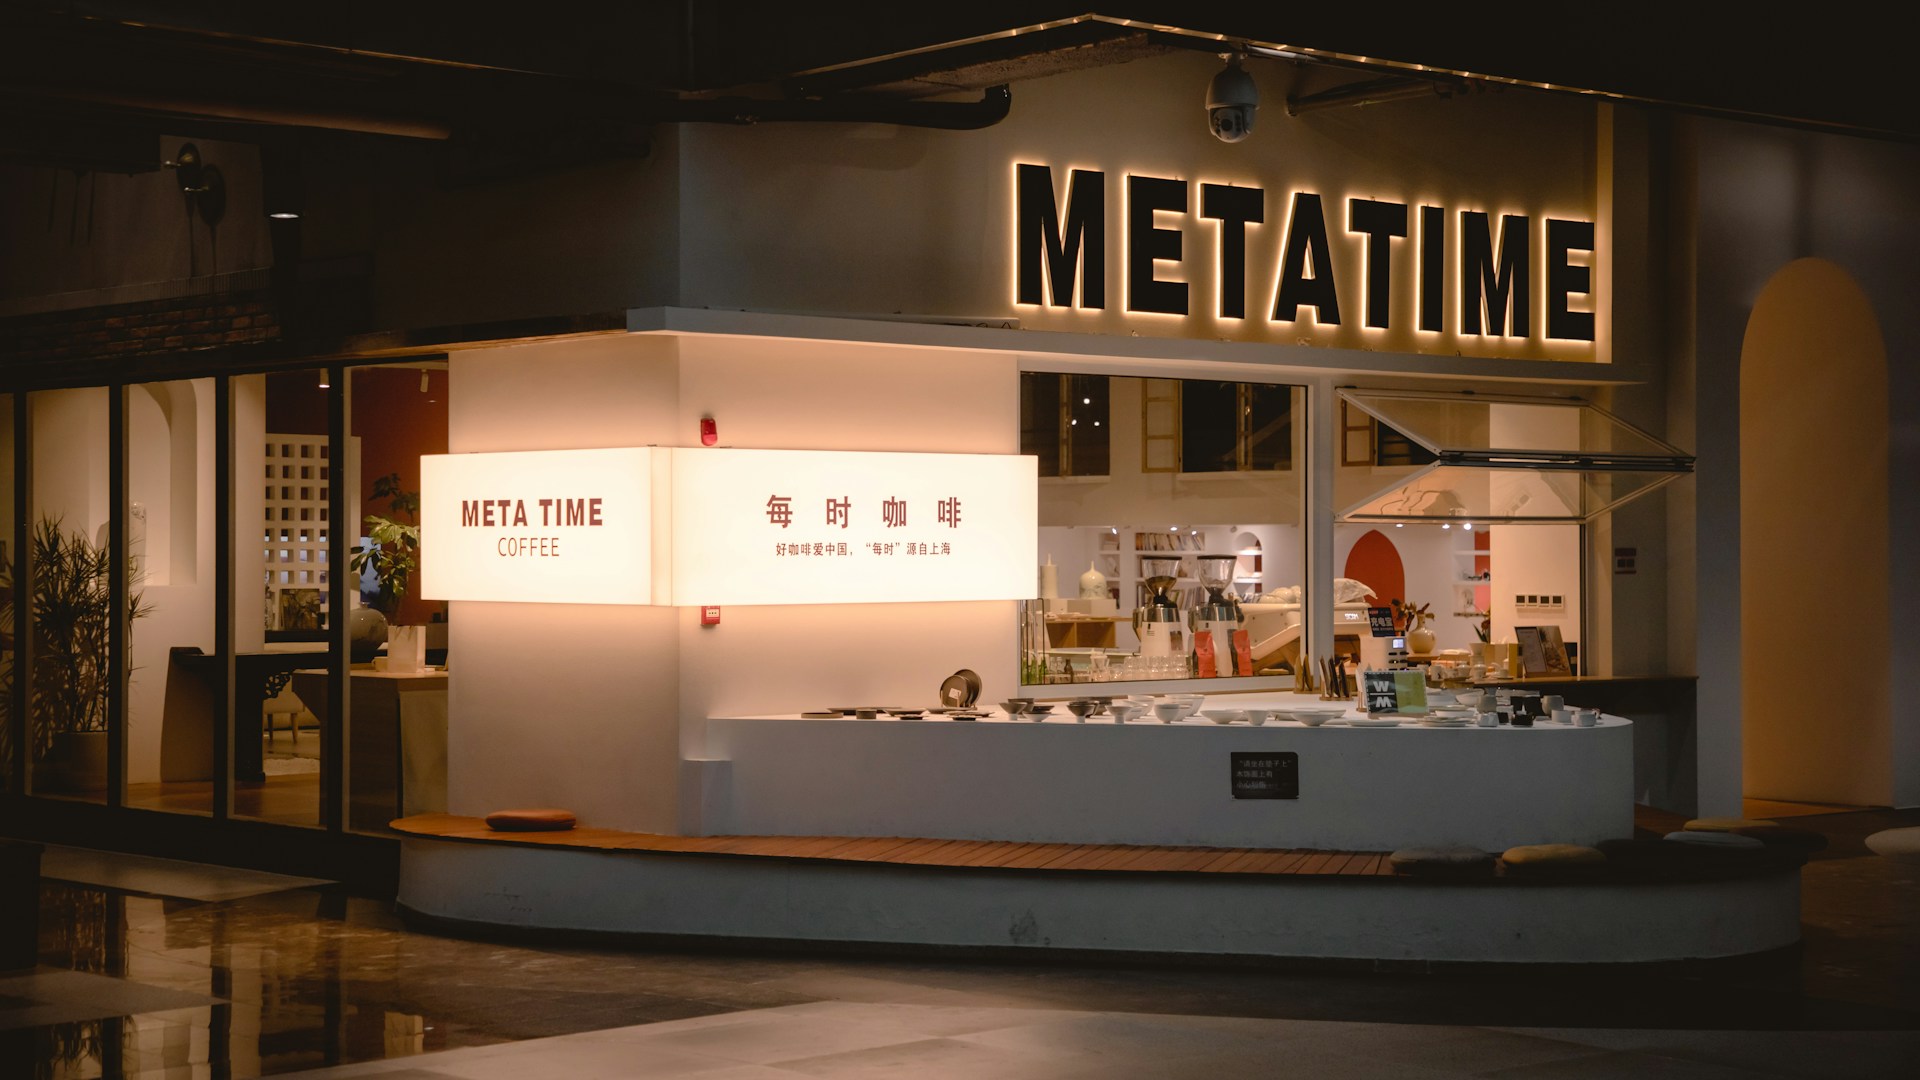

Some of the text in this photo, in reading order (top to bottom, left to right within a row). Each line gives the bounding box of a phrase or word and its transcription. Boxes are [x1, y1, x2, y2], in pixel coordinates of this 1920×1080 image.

[1016, 162, 1595, 342] METATIME
[462, 498, 603, 527] META TIME
[766, 494, 962, 529] 每时咖啡
[498, 537, 560, 557] COFFEE
[1373, 681, 1389, 692] W
